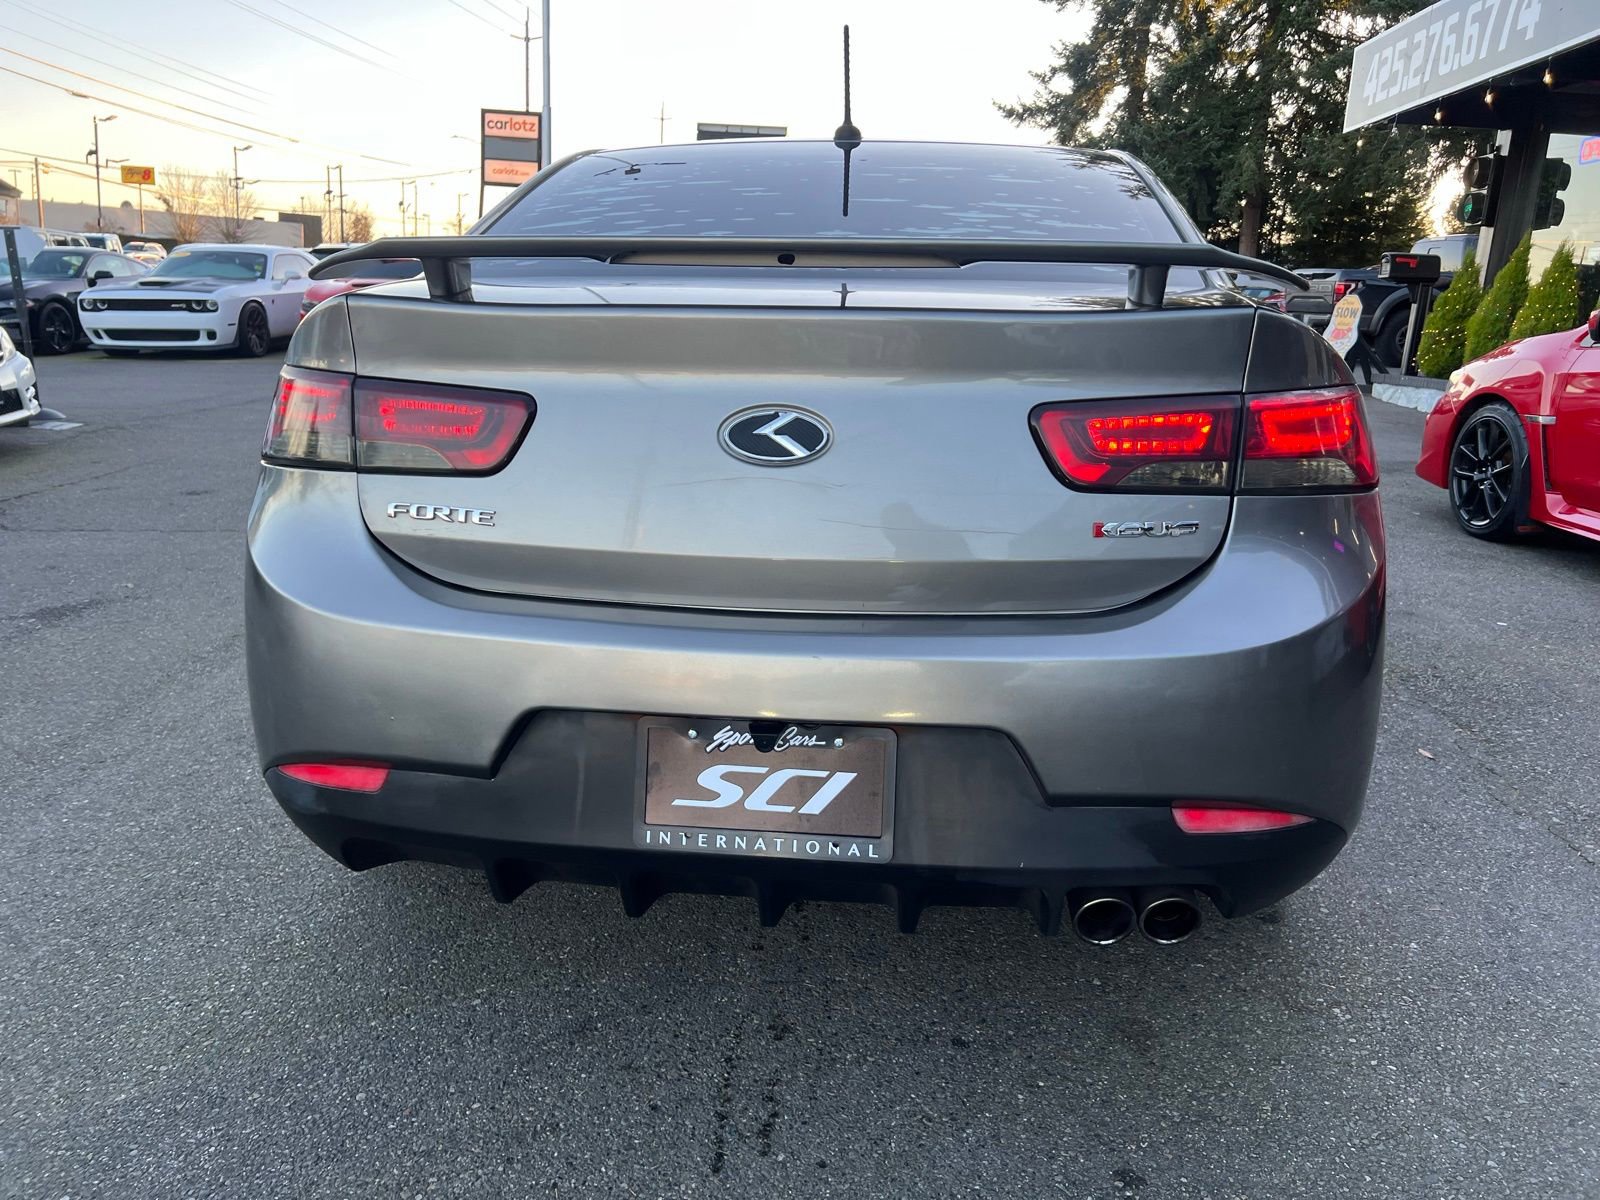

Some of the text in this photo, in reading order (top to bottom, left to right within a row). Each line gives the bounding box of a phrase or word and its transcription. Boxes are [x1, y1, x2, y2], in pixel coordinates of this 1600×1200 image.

[1363, 0, 1542, 106] 425.276.6774
[486, 117, 536, 132] carlotz
[1335, 306, 1359, 318] SLOW
[387, 502, 496, 526] FORTE
[705, 725, 826, 752] Spo Cars
[671, 764, 858, 815] SCI
[646, 830, 879, 858] INTERNATIONAL
